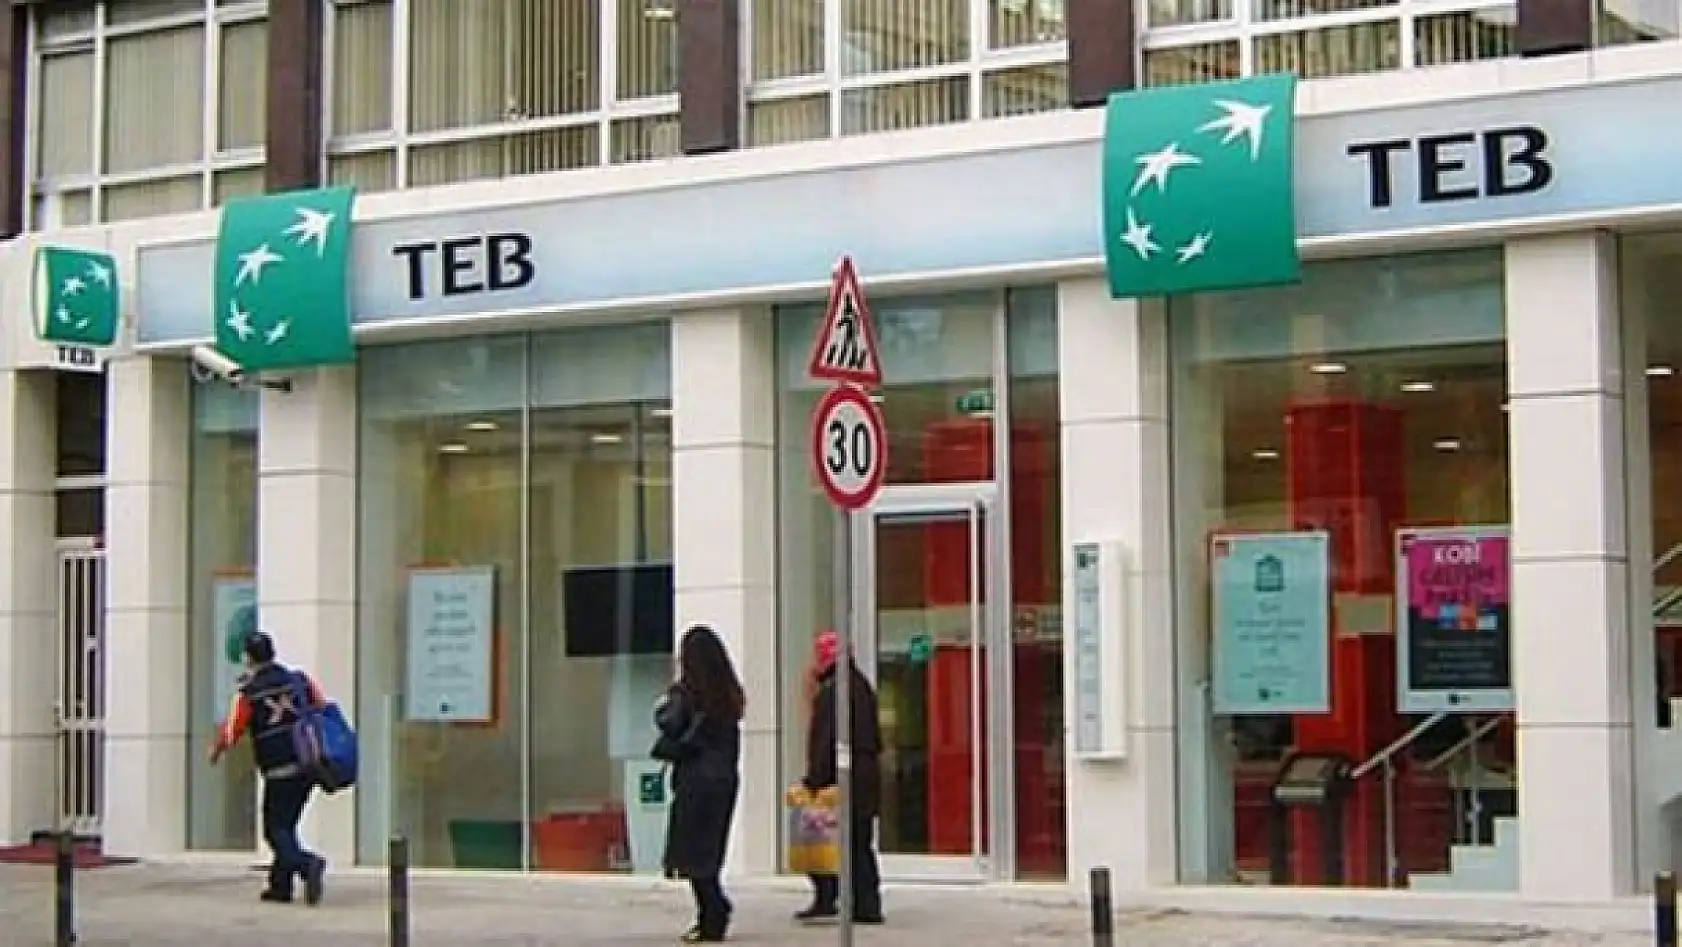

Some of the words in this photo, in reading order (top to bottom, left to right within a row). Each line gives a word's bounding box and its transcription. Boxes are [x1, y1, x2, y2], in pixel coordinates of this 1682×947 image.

[1346, 125, 1553, 208] TEB
[392, 233, 535, 300] TEB
[57, 345, 96, 365] TEB
[826, 420, 872, 476] 30
